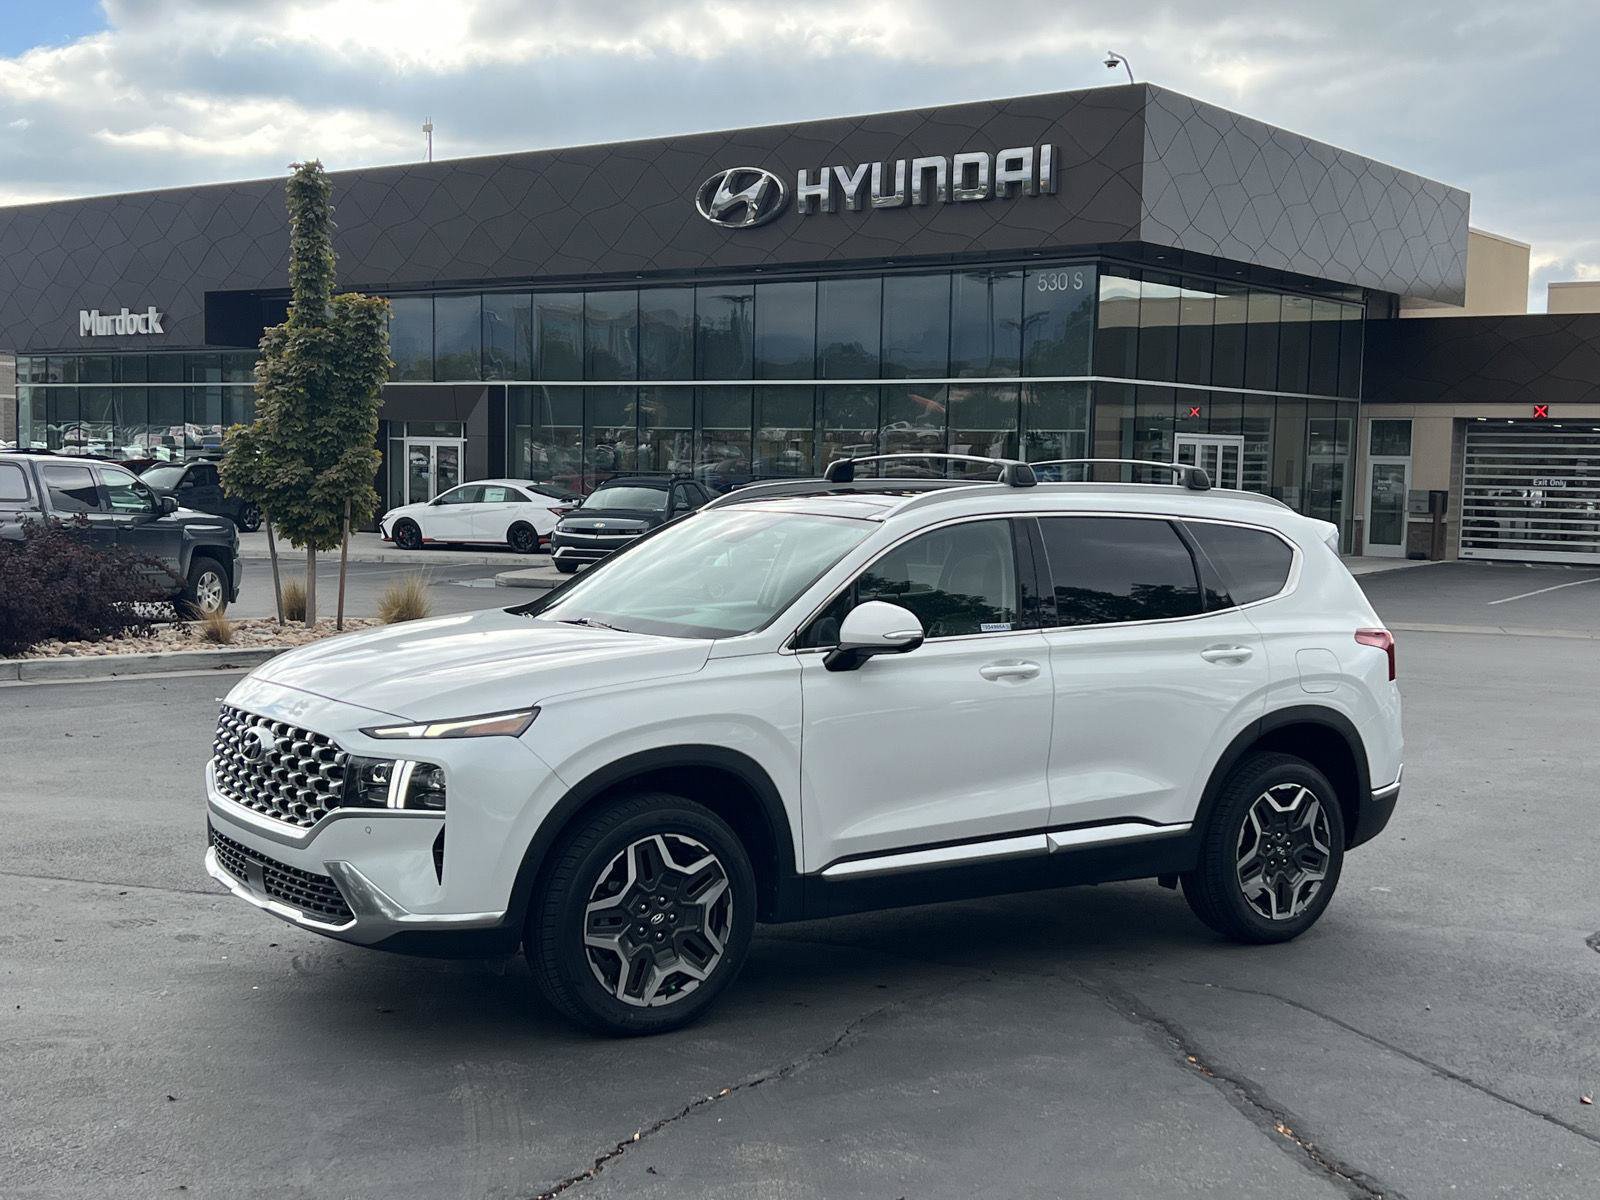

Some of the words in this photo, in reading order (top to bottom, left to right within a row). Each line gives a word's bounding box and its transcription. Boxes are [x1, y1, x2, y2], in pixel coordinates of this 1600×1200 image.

[797, 143, 1056, 214] HYUNDAI
[1037, 272, 1068, 291] 530
[1073, 271, 1083, 290] S
[79, 306, 164, 337] Murdock
[1533, 478, 1548, 486] Exit
[1549, 479, 1567, 489] Only
